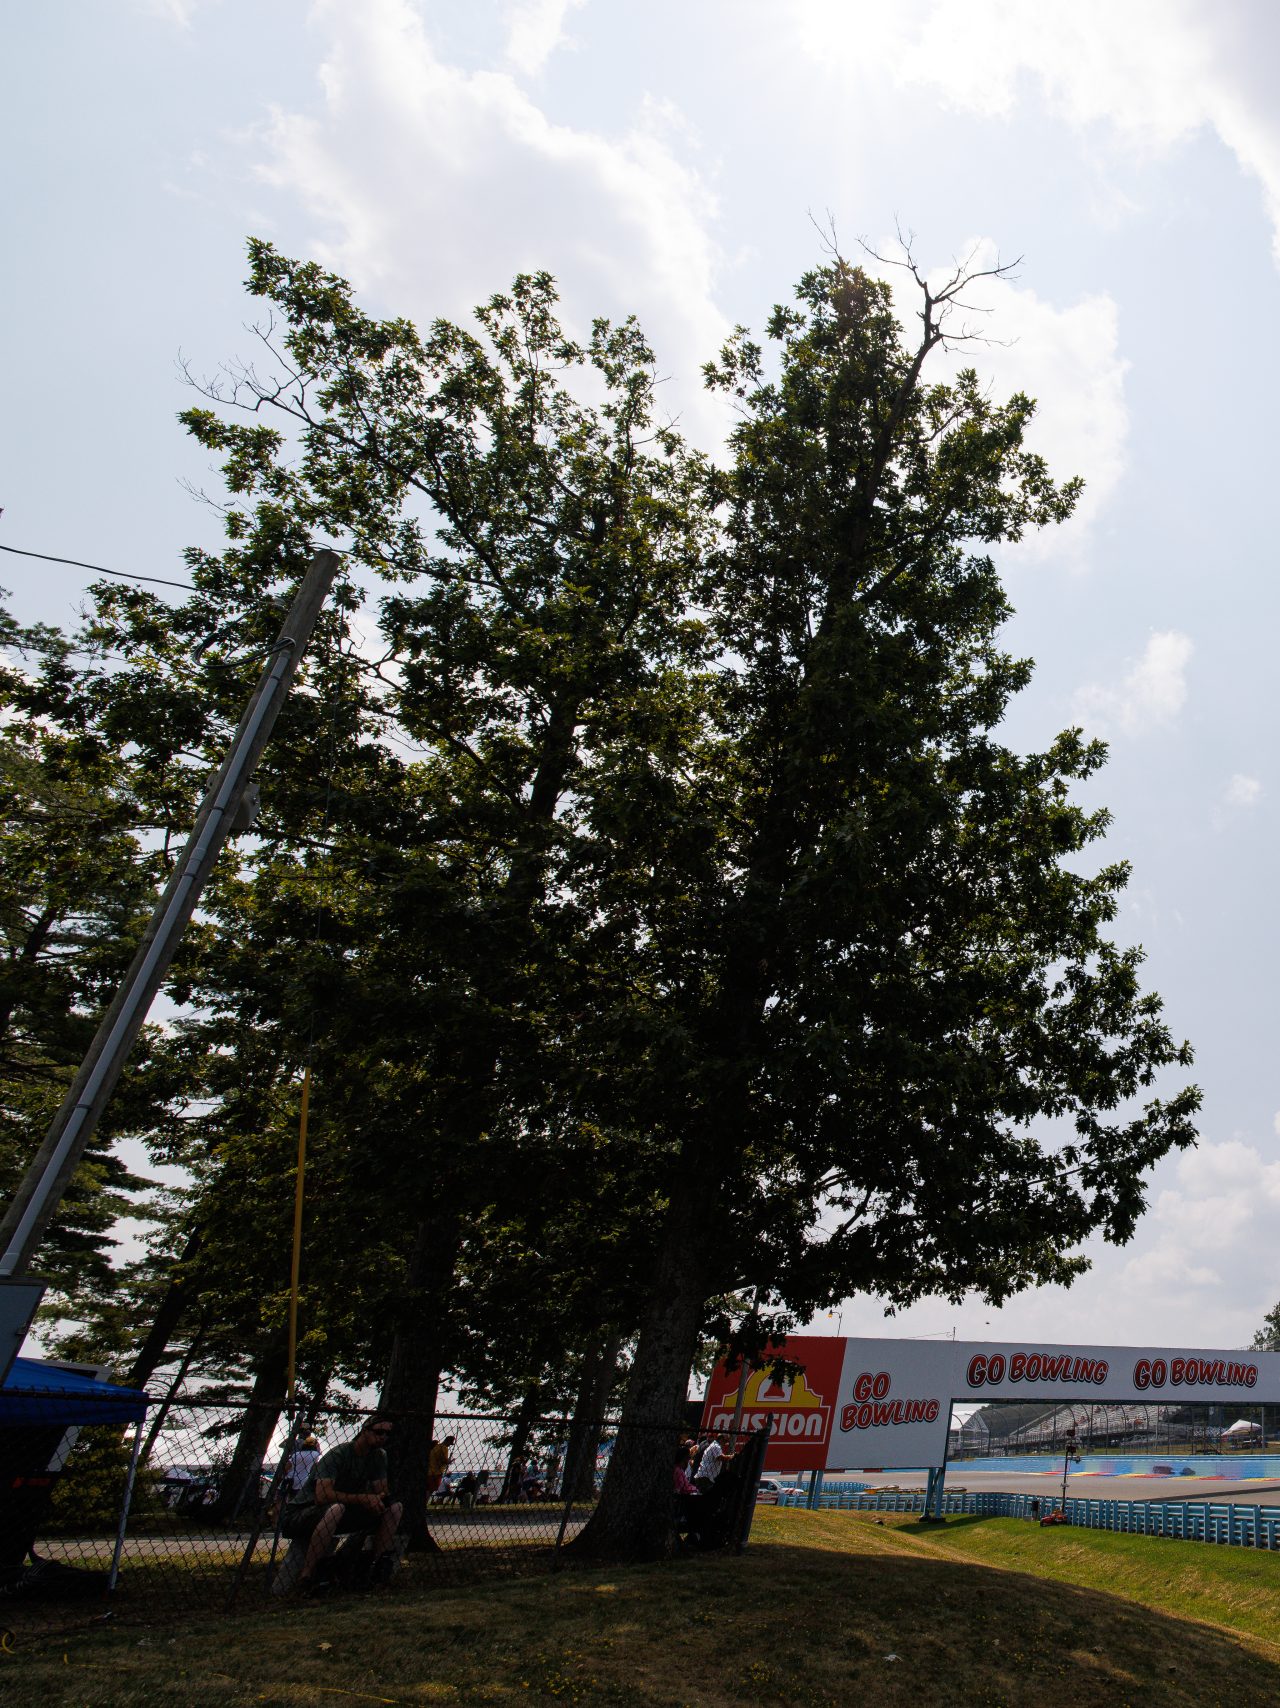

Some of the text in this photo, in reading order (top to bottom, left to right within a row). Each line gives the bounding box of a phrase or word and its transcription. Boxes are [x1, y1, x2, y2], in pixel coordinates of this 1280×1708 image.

[967, 1353, 1109, 1387] GO BOWLING
[1133, 1358, 1258, 1390] GO BOWLING
[853, 1372, 891, 1402] GO
[839, 1399, 940, 1432] BOWLING
